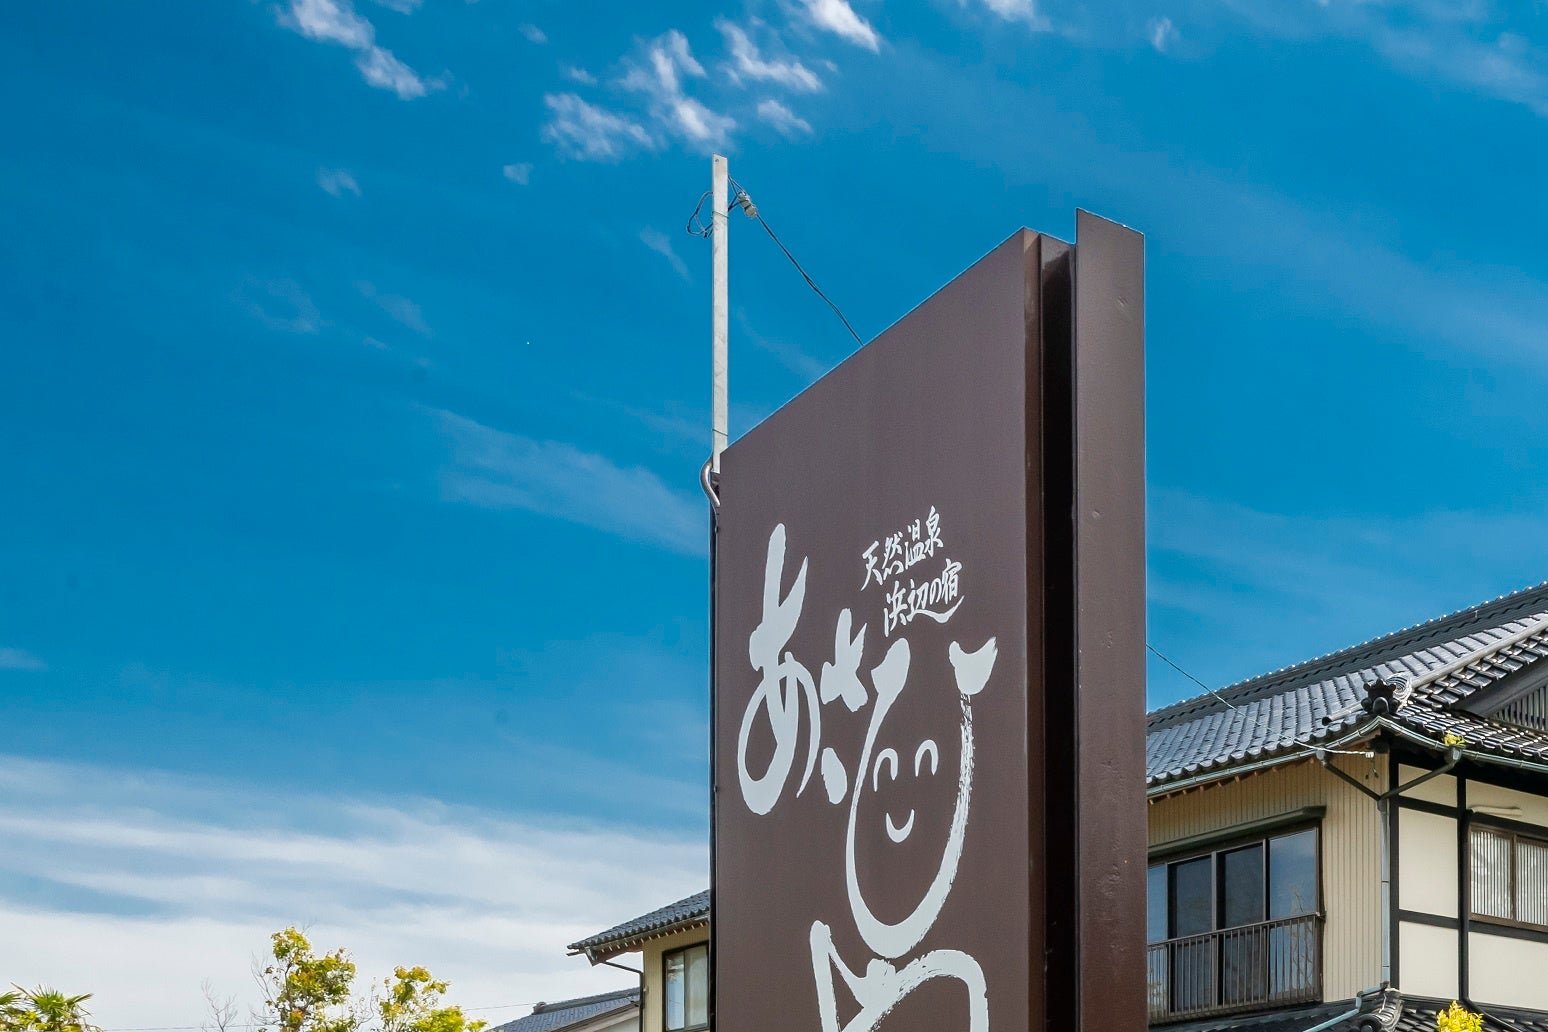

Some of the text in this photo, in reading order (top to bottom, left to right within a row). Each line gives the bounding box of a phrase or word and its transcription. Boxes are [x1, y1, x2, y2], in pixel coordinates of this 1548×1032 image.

[860, 505, 944, 591] 天然温泉
[884, 558, 965, 637] 浜辺の宿
